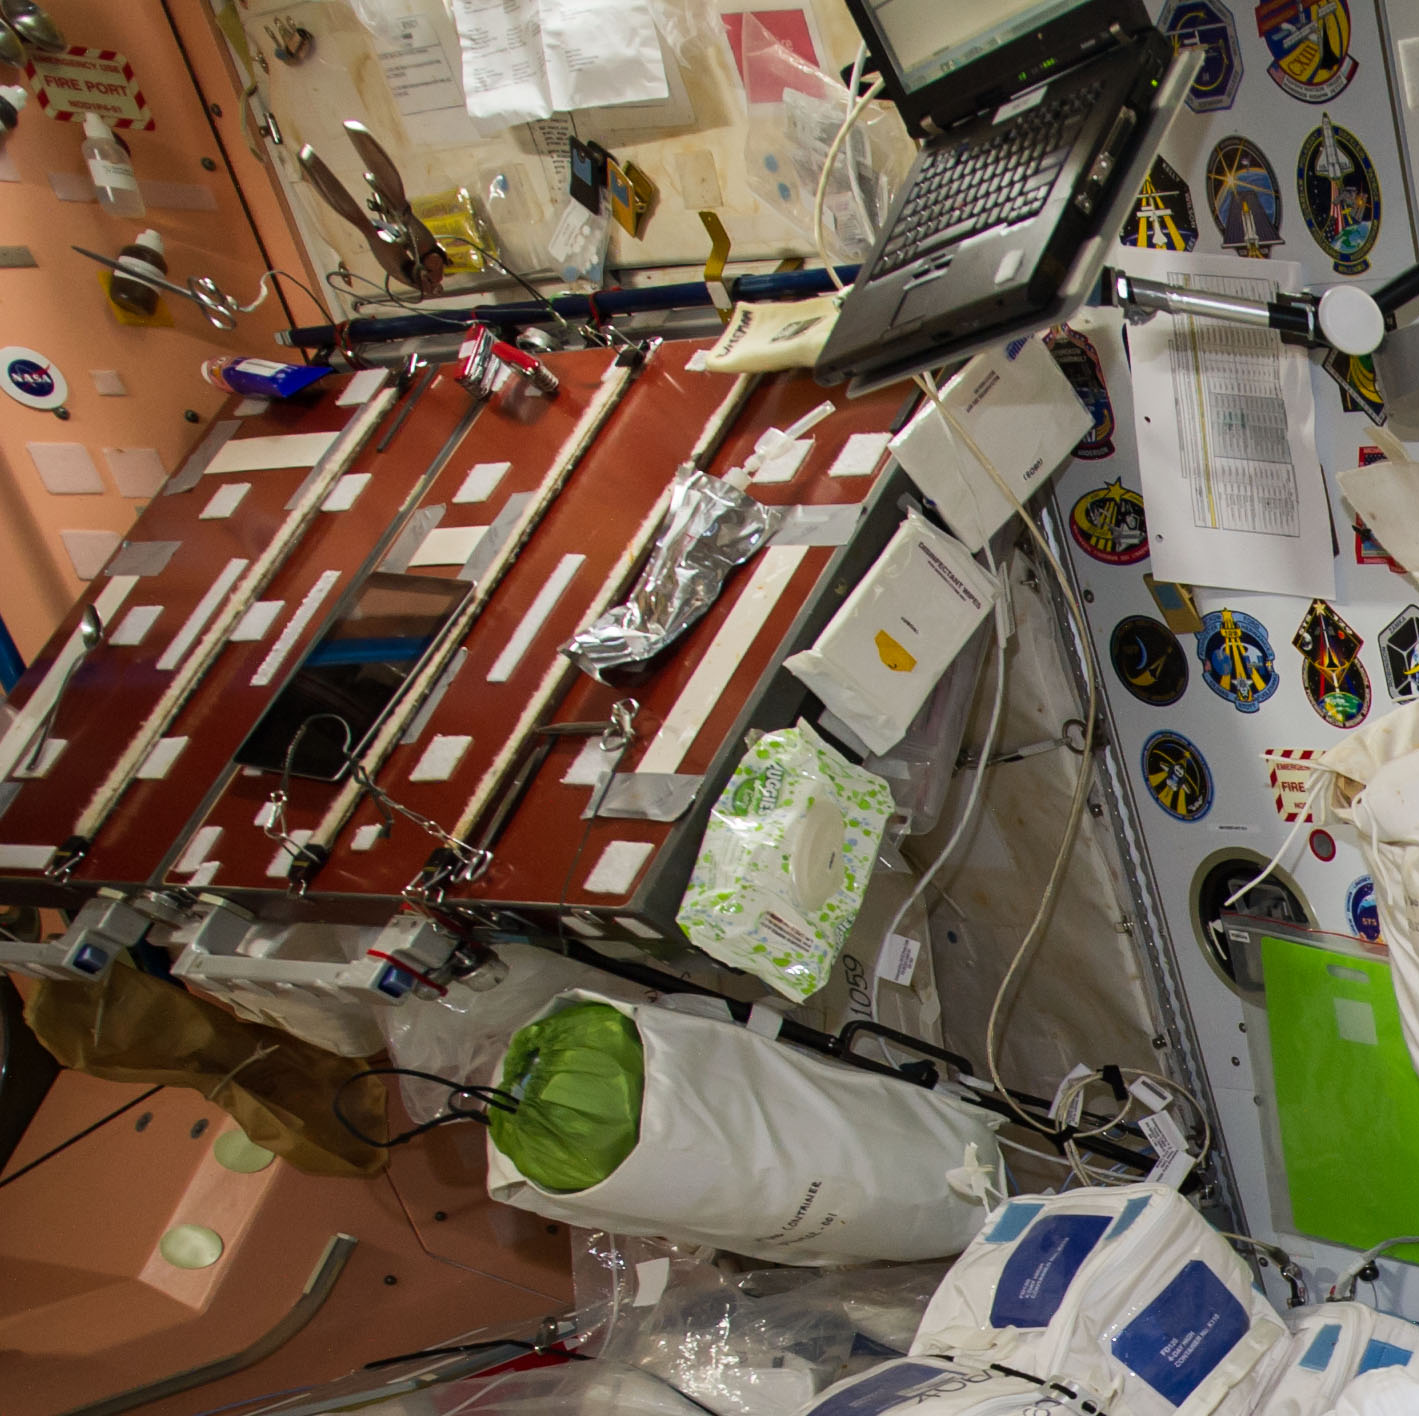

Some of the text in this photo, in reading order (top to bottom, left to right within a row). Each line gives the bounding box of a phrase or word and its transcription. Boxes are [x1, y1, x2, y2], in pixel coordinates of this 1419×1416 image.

[44, 74, 128, 97] FIRE PORT
[11, 372, 52, 383] NASA
[917, 541, 964, 589] DISINFECTANT
[1280, 781, 1306, 793] FIRE
[842, 953, 873, 1019] 1059
